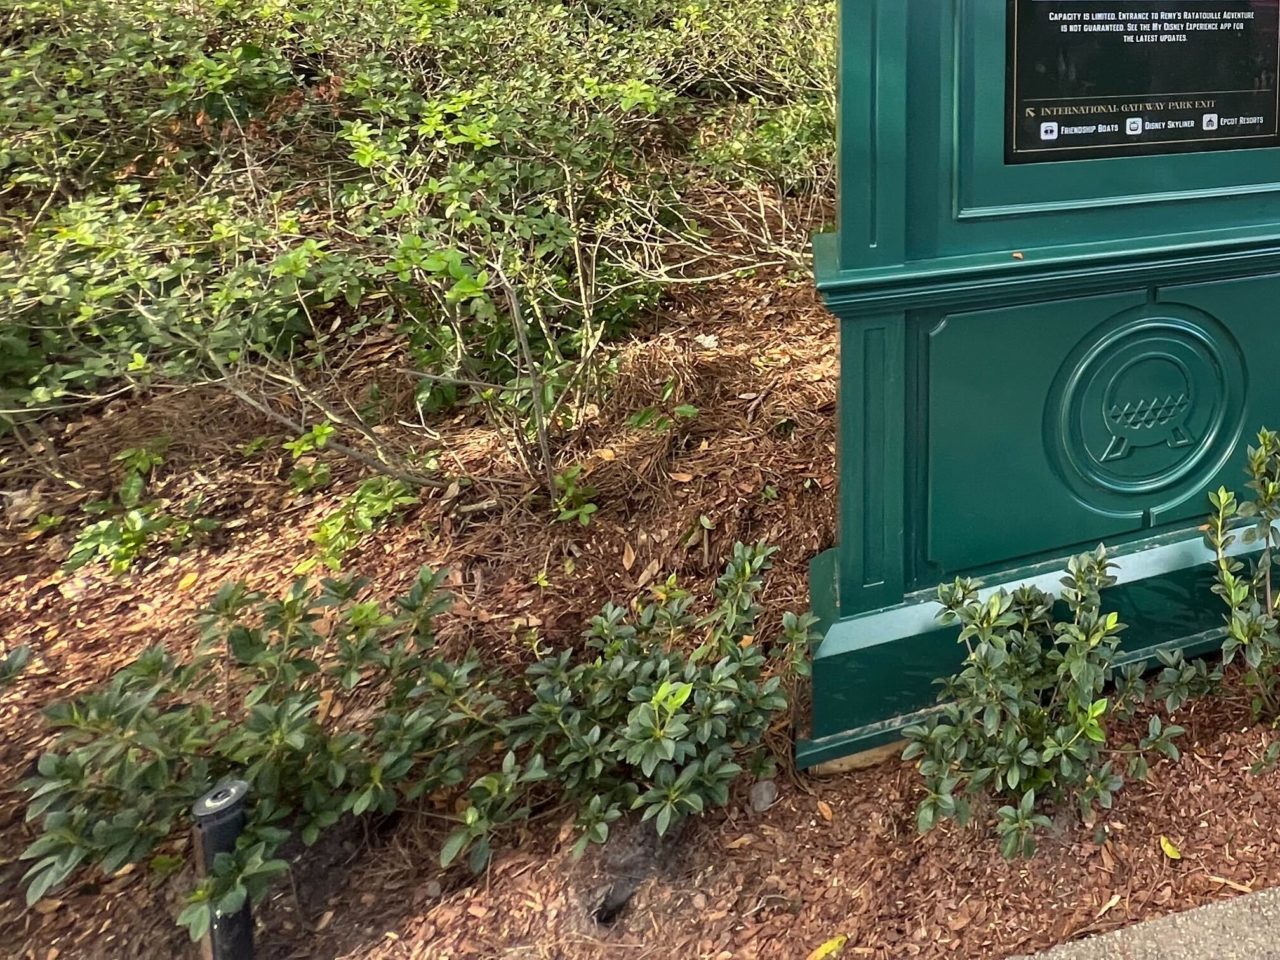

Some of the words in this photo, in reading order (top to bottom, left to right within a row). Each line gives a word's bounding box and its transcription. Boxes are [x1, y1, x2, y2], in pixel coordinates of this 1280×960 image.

[1048, 11, 1081, 21] CAPACITY
[1118, 11, 1149, 20] ENTRANCE
[1160, 11, 1182, 20] REMY'S
[1183, 11, 1221, 20] RATATOUILLE
[1223, 10, 1255, 19] ADVENTURE
[1127, 22, 1138, 32] SEE
[1152, 22, 1161, 31] MY
[1163, 22, 1184, 31] DISNEY
[1186, 22, 1218, 31] EXPERIENCE
[1041, 104, 1119, 116] INTERNATIONAL
[1121, 102, 1165, 113] GATEWAY
[1168, 100, 1193, 110] PARK
[1195, 100, 1216, 108] EXIT
[1144, 121, 1165, 130] DISNEY
[1167, 120, 1195, 129] SKYLINER
[1220, 117, 1238, 126] EPCOT
[1240, 116, 1264, 124] RESORTS
[1060, 125, 1096, 135] FRIENDSHIP
[1098, 123, 1119, 133] BOATS
